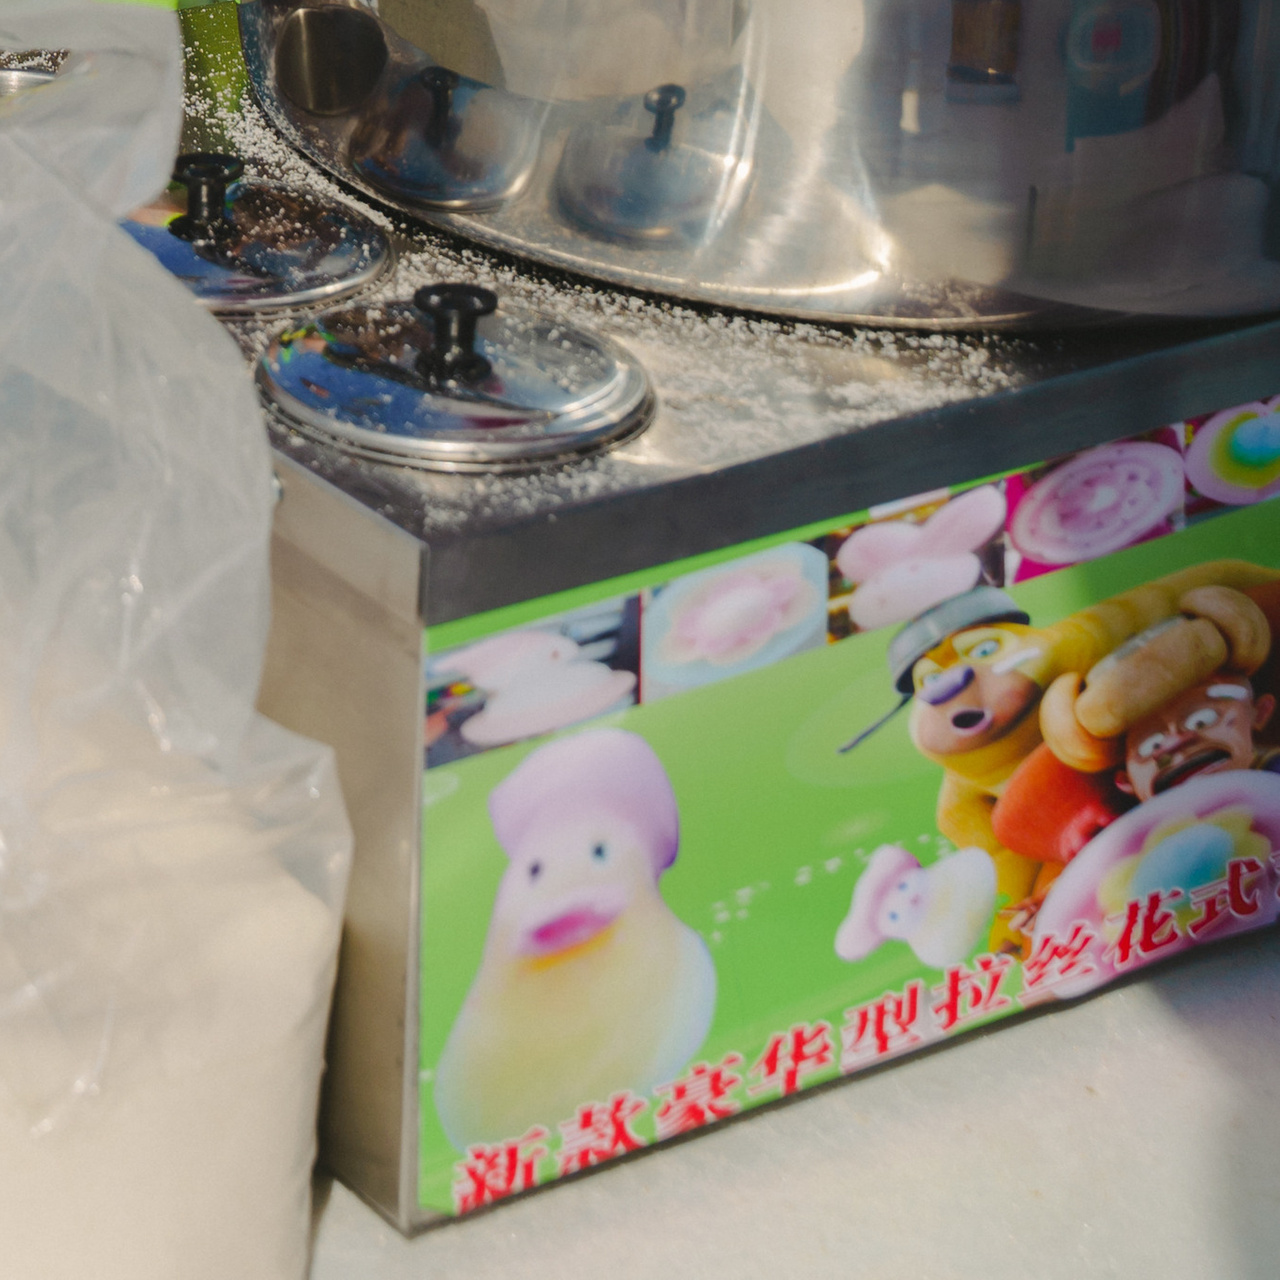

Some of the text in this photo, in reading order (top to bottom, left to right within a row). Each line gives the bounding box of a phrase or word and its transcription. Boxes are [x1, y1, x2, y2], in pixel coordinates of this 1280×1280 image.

[453, 852, 1280, 1215] 新款豪华型拉丝花式
